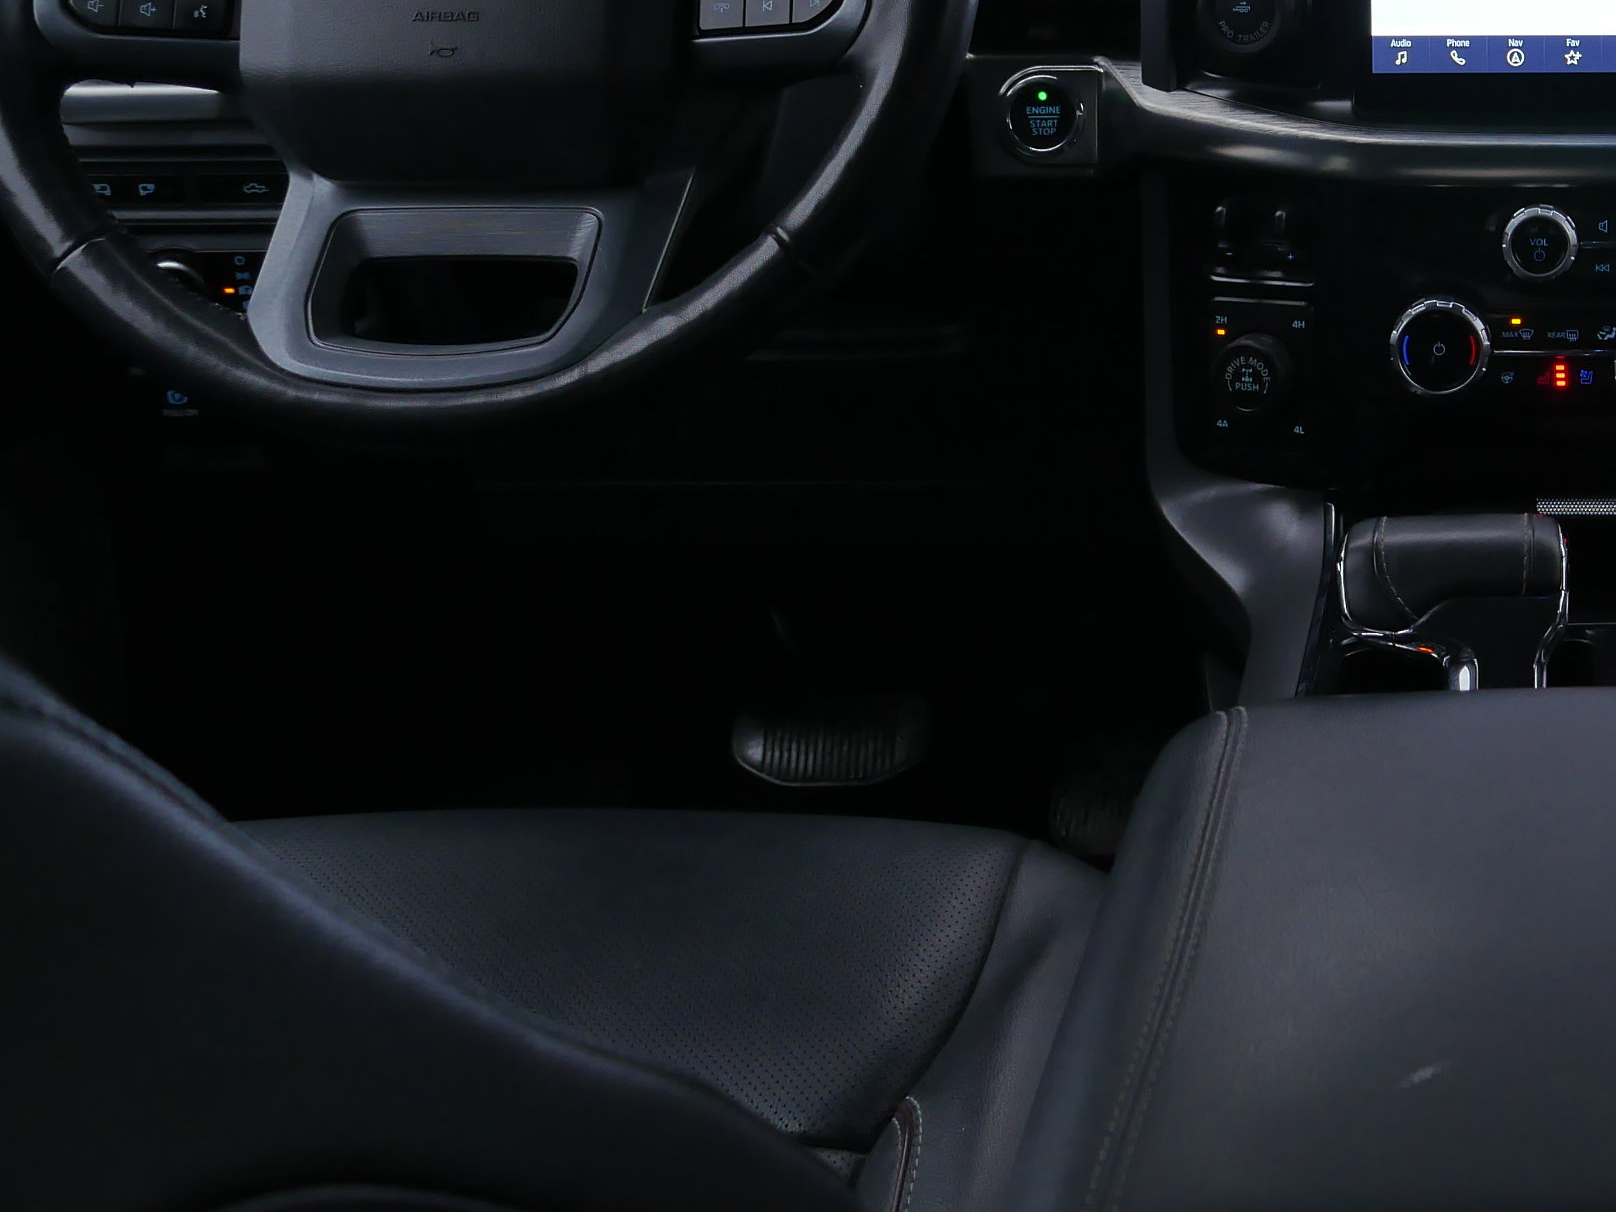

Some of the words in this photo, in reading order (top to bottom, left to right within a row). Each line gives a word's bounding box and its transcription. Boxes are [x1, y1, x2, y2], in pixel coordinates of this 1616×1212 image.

[412, 10, 480, 22] AIRBAG
[1217, 19, 1235, 38] PRO
[1238, 21, 1269, 43] TRAILER
[1391, 38, 1412, 47] Audio
[1446, 38, 1470, 47] Phone
[1508, 38, 1523, 47] Nav
[1566, 38, 1580, 47] Fav
[1026, 106, 1061, 114] ENGINE
[1029, 119, 1058, 128] START
[1032, 127, 1057, 136] STOP
[1529, 237, 1549, 246] VOL
[1215, 315, 1228, 324] 2H
[1292, 320, 1305, 329] 4H
[1502, 331, 1518, 339] MAX
[1547, 331, 1566, 339] REAR
[1225, 355, 1248, 380] DRIVE
[1247, 356, 1271, 382] MODE
[1235, 382, 1259, 392] PUSH
[1216, 419, 1229, 428] 4A
[1293, 426, 1305, 435] 4L
